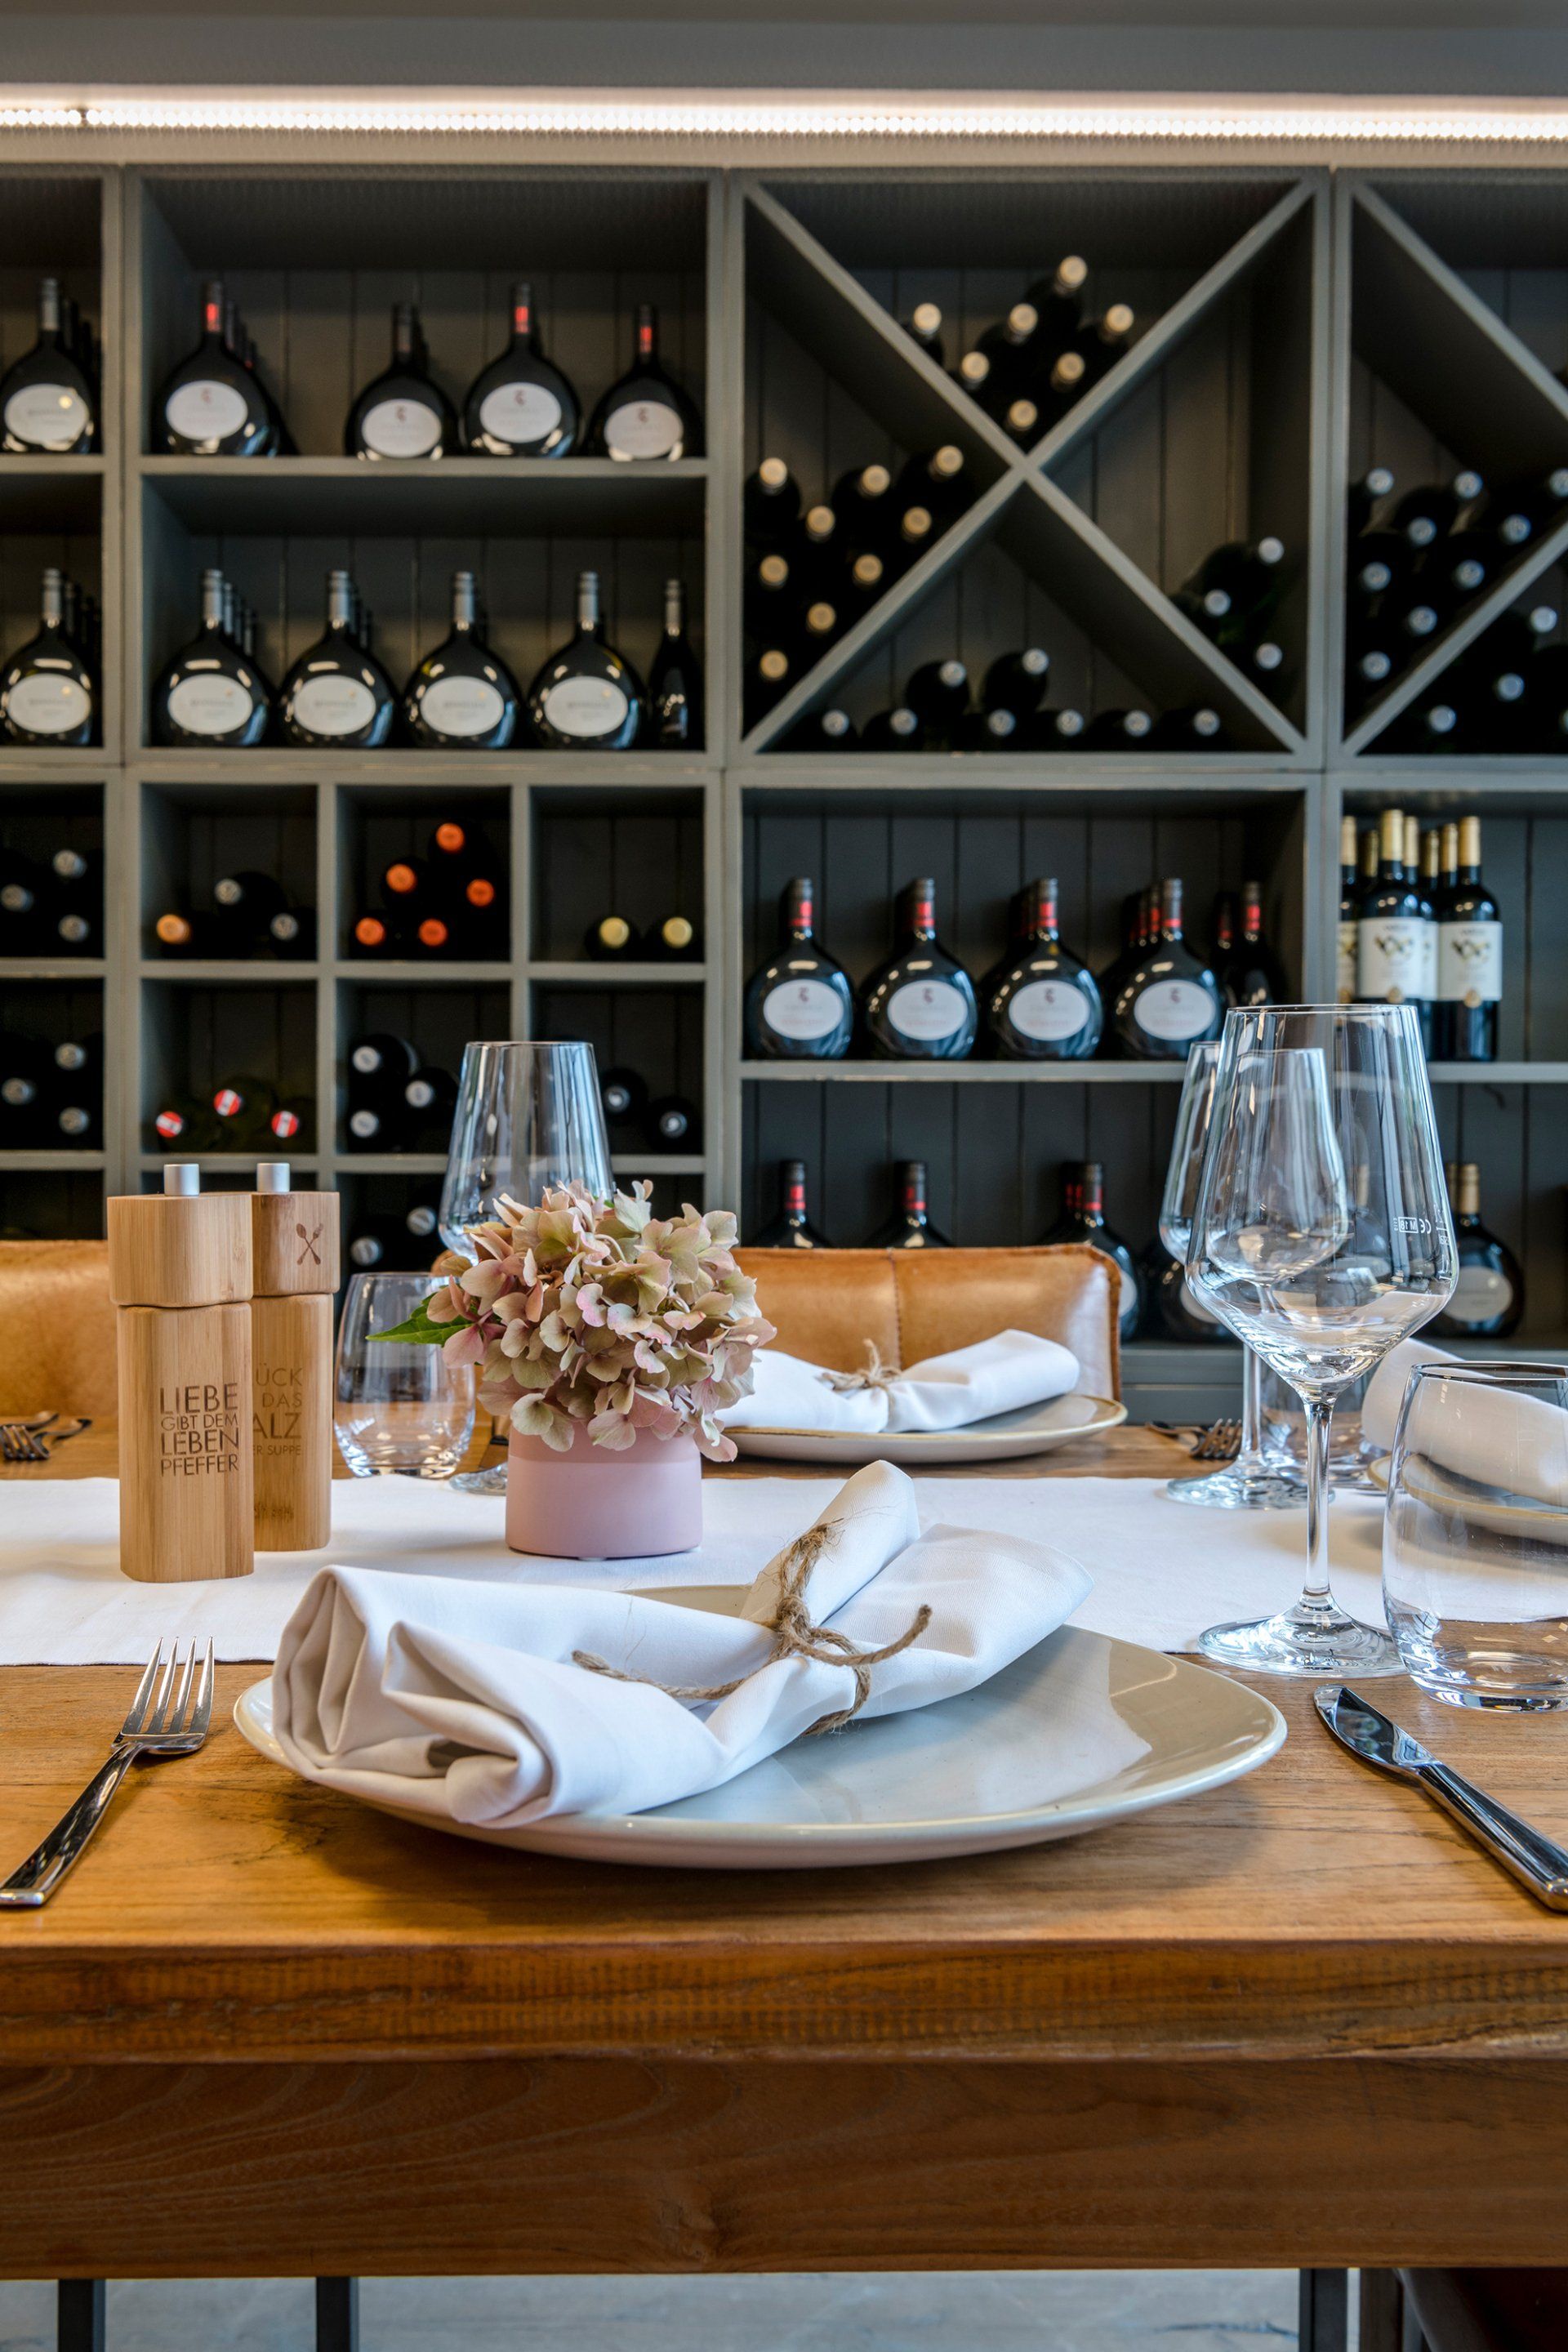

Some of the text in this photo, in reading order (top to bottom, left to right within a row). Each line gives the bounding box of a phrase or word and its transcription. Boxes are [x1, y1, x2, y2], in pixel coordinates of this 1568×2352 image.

[256, 1362, 303, 1387] ÜCK
[160, 1383, 238, 1414] LIEBE
[262, 1392, 302, 1408] DAS
[161, 1413, 238, 1431] GIBT DEM
[252, 1412, 302, 1439] ALZ
[161, 1428, 239, 1455] LEBEN
[267, 1445, 301, 1456] SUPPE
[161, 1454, 239, 1477] PFEFFER
